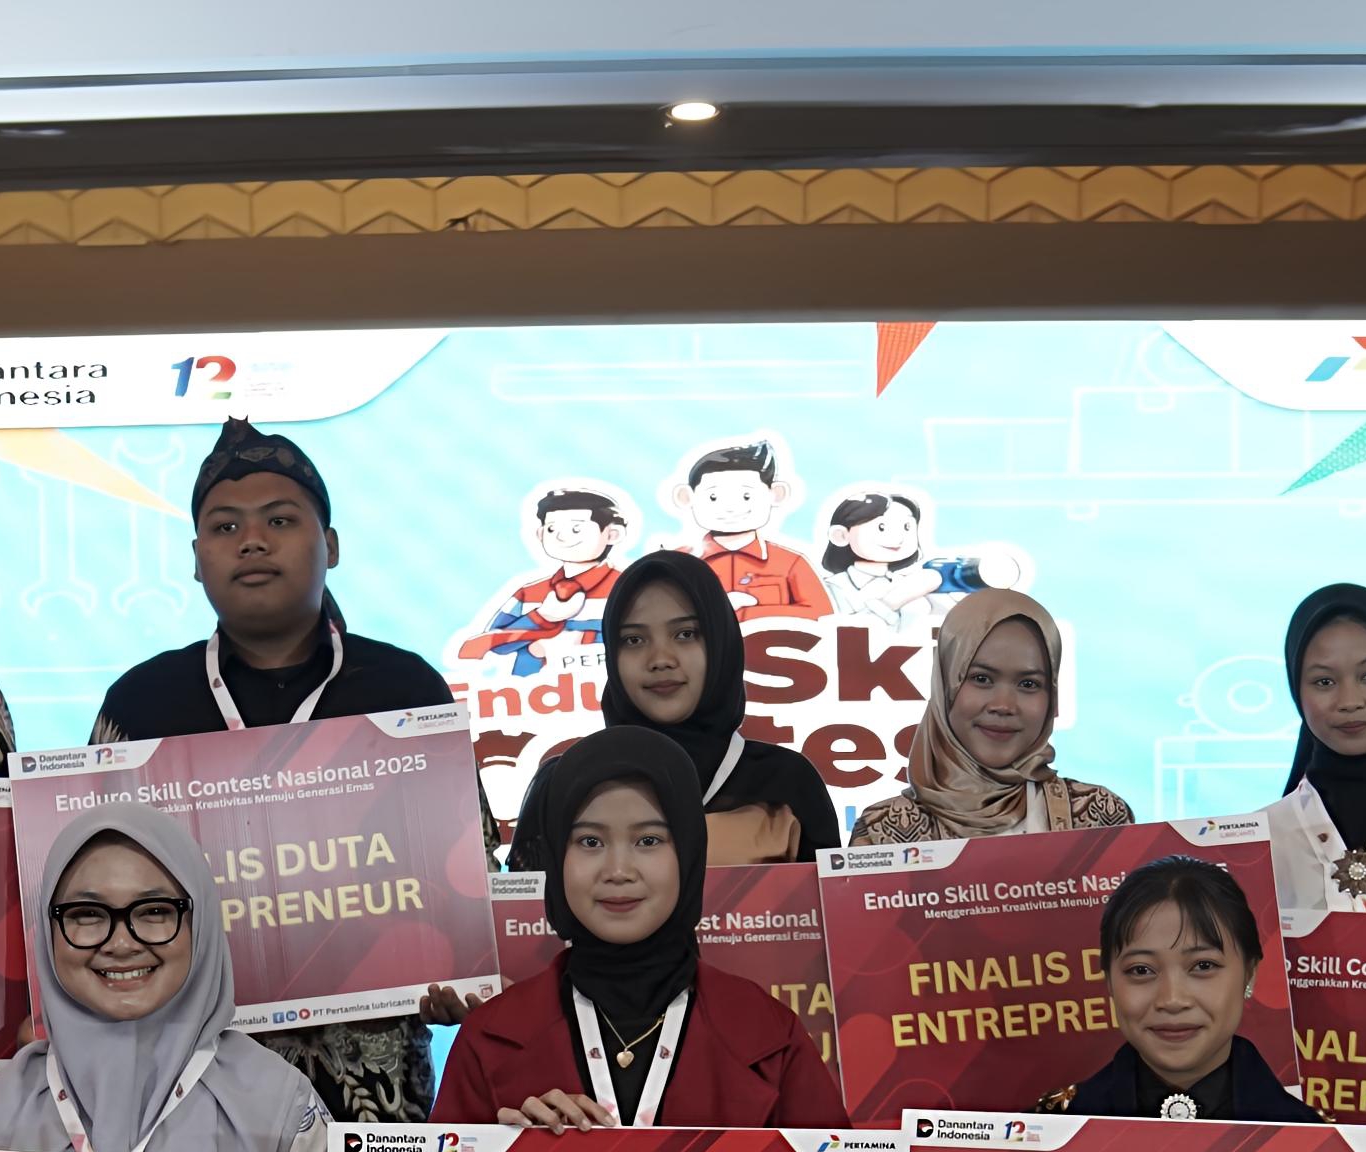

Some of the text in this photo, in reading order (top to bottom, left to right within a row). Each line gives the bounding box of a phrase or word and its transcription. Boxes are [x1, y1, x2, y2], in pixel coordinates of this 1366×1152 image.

[171, 356, 236, 399] 12
[449, 673, 602, 718] ndu
[138, 782, 182, 803] Skill
[187, 774, 272, 799] Contest
[277, 763, 370, 788] Nasional
[375, 754, 426, 776] 2025
[276, 833, 395, 876] DUTA
[222, 878, 423, 931] PRENEUR
[864, 879, 1077, 910] Enduro Skill Contest
[726, 909, 818, 929] Nasional
[909, 952, 1070, 995] FINALIS
[1298, 956, 1341, 974] Skill
[892, 997, 1119, 1047] ENTREPRE
